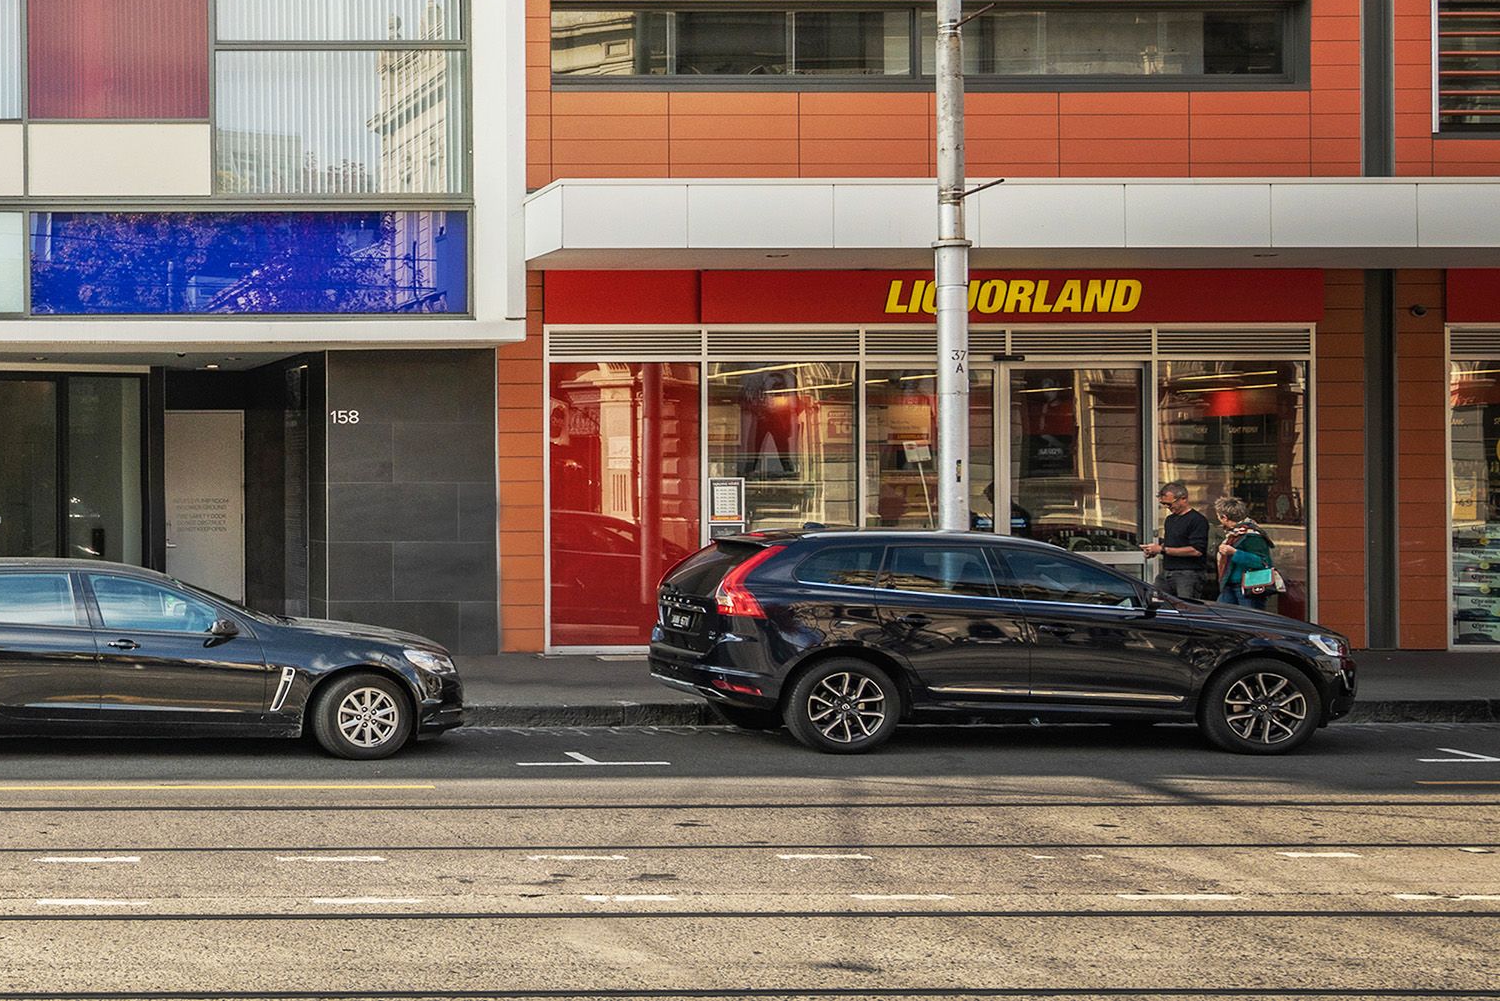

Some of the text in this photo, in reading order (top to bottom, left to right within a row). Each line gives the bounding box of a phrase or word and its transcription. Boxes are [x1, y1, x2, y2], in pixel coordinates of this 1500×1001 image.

[951, 349, 967, 361] 37
[955, 362, 965, 374] A
[330, 410, 360, 424] 158
